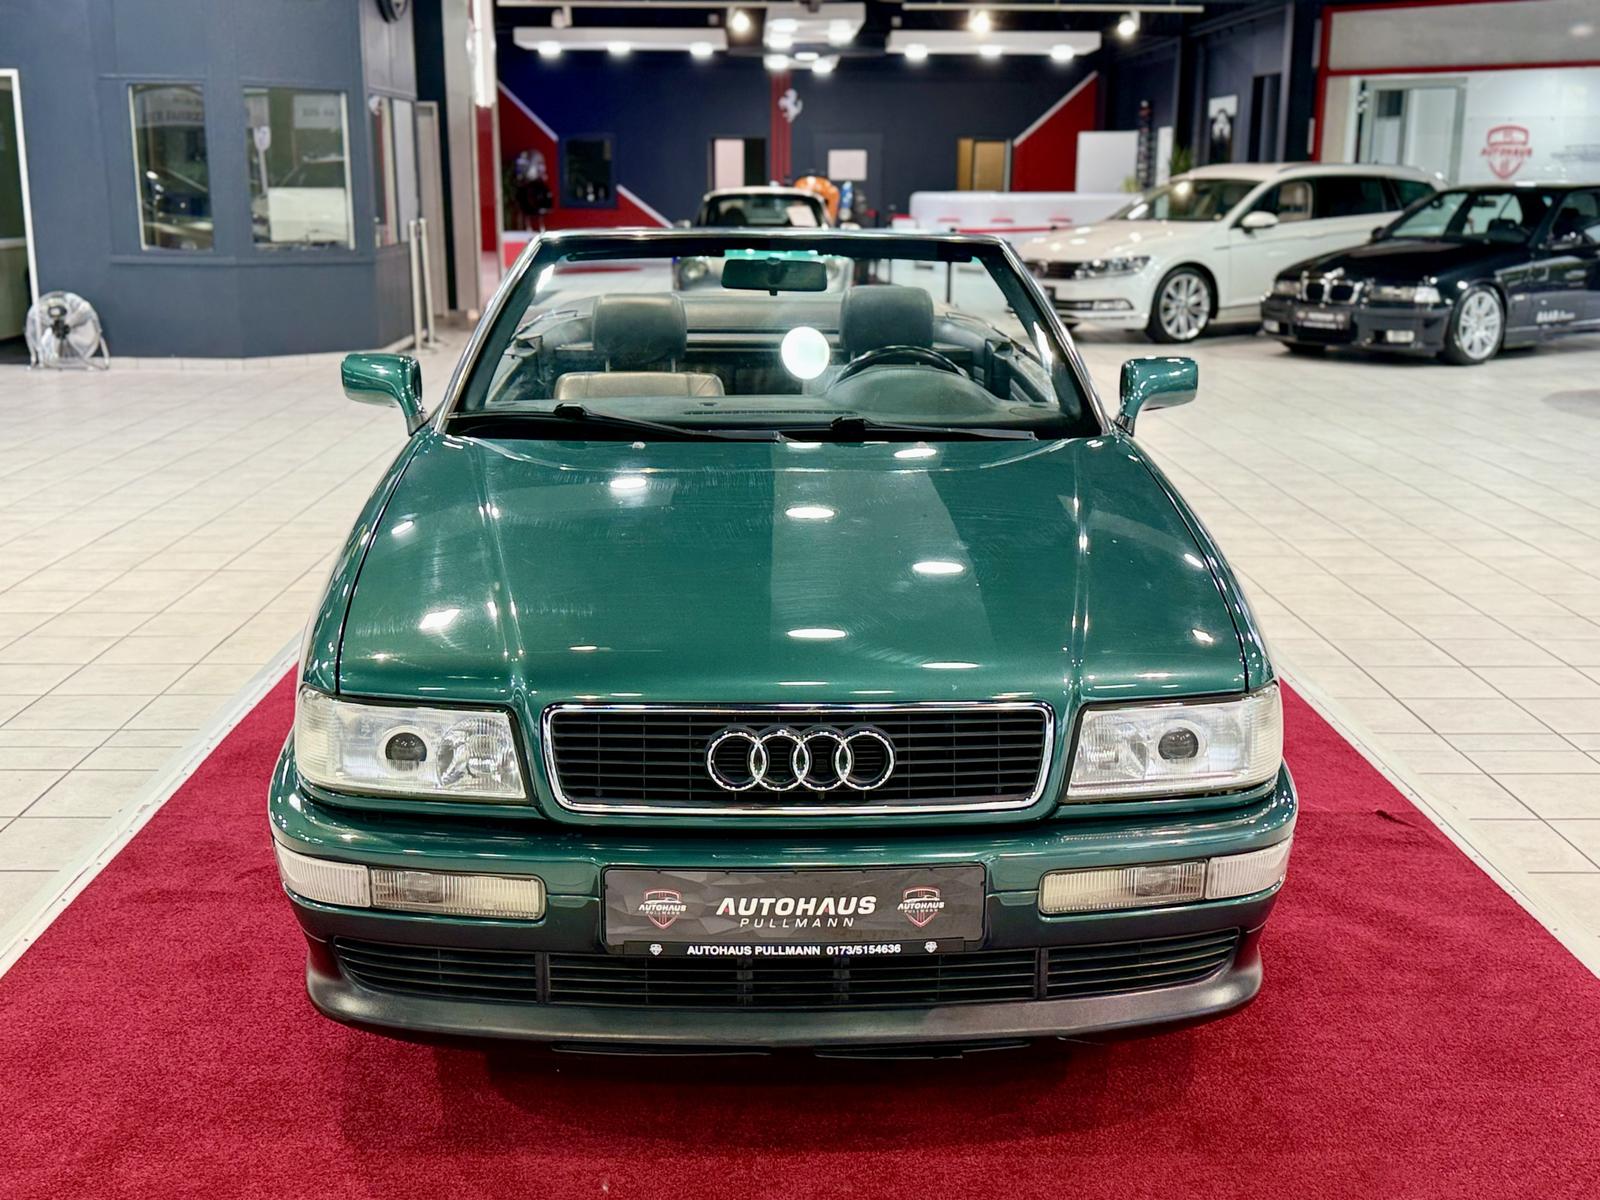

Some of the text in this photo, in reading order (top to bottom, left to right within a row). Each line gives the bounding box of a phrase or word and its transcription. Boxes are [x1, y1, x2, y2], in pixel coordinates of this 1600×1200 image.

[716, 897, 876, 915] AUTOHAUS
[897, 902, 944, 910] AUTOHAUS
[740, 917, 854, 928] PULLMANN
[687, 943, 902, 956] AUTOHAUS PULLMANN 0173/5154636
